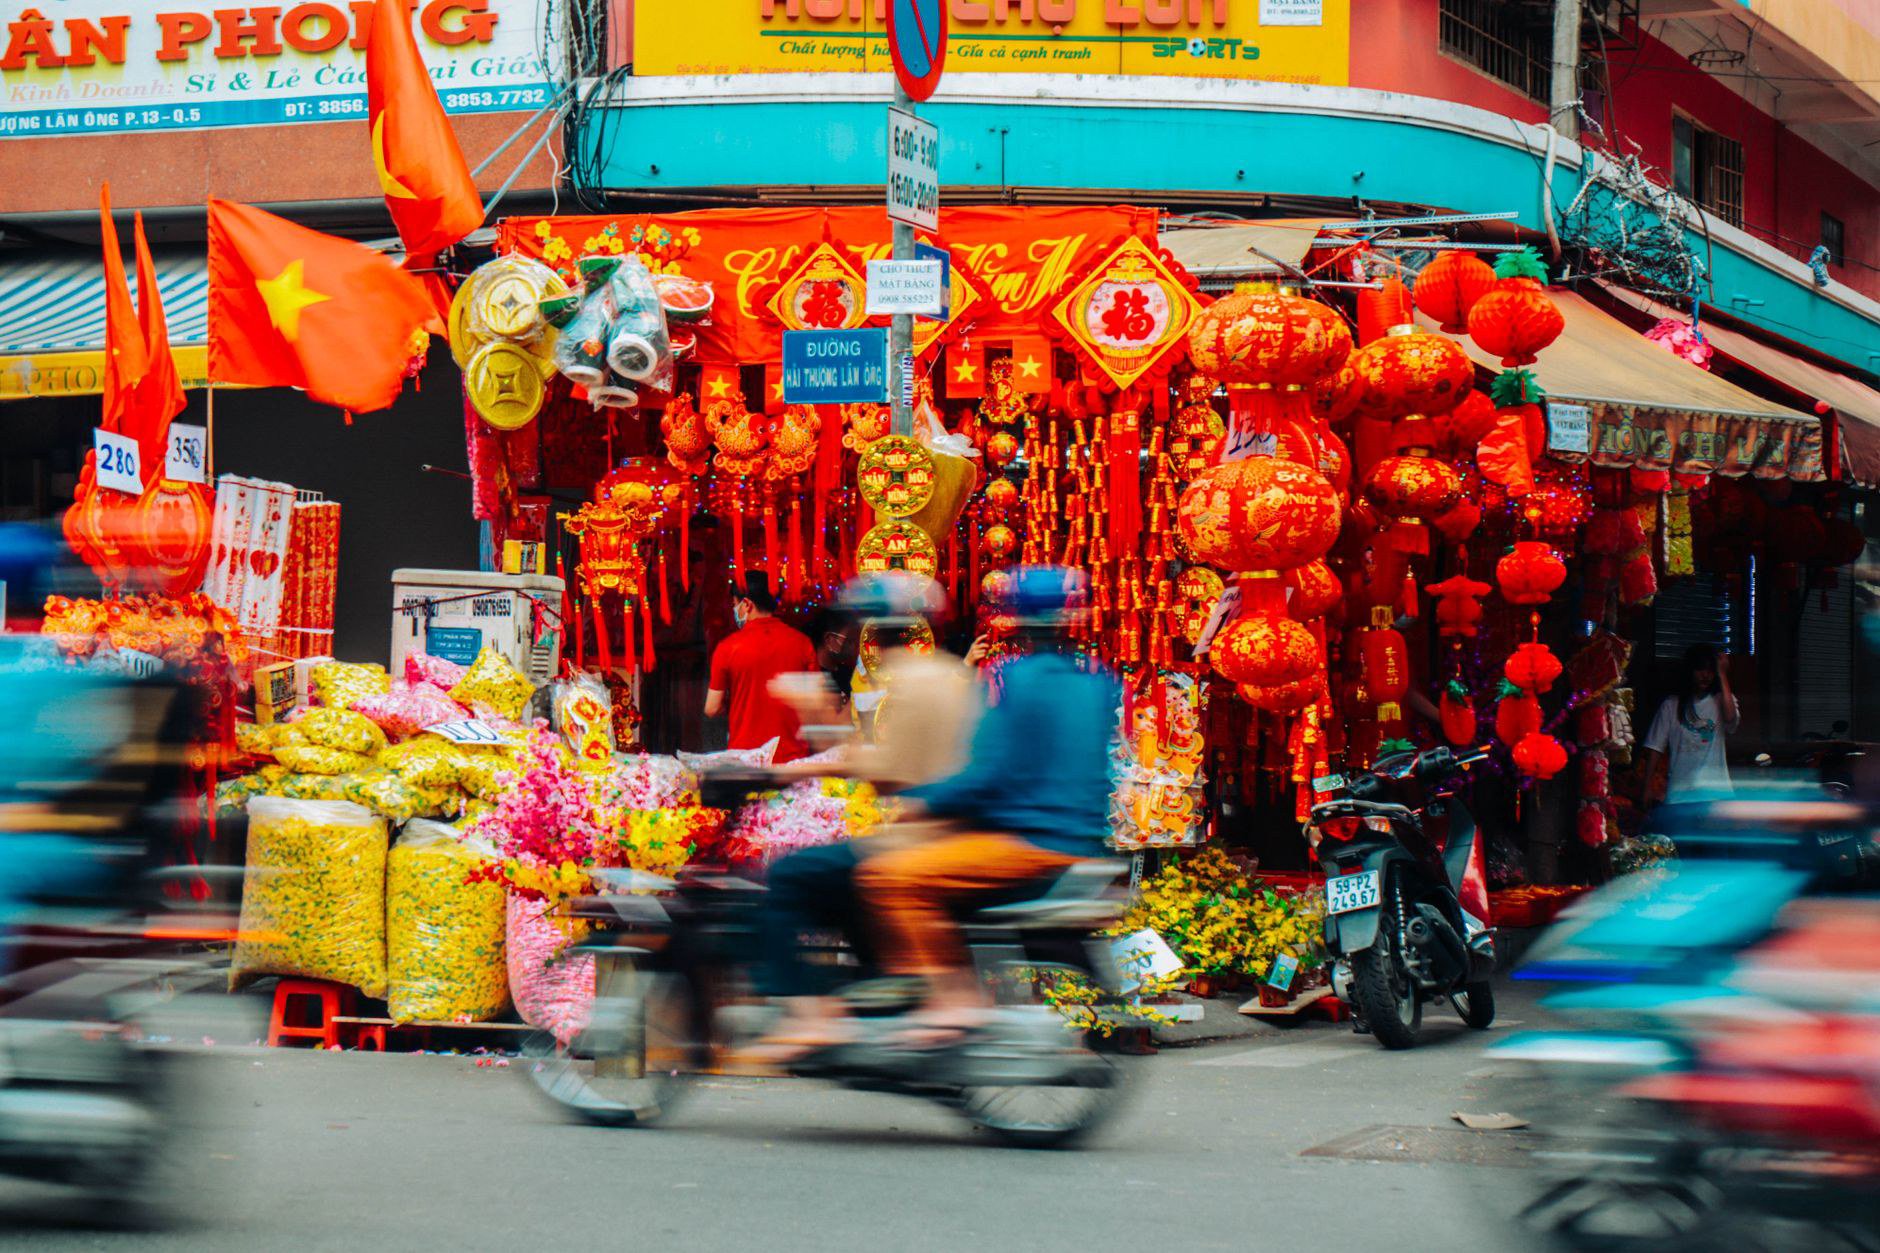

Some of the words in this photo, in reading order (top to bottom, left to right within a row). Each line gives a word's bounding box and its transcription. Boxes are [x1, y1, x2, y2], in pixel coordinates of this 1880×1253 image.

[1011, 46, 1047, 62] cạnh
[1052, 47, 1091, 59] tranh
[228, 71, 253, 91] &
[446, 88, 546, 108] 3853.7732
[84, 110, 119, 126] ÔNG
[1102, 288, 1155, 341] 福
[806, 338, 861, 357] ĐƯỜNG
[100, 442, 136, 477] 280
[887, 539, 907, 551] AN
[1336, 874, 1371, 894] 59-P2
[1332, 888, 1377, 912] 249.67
